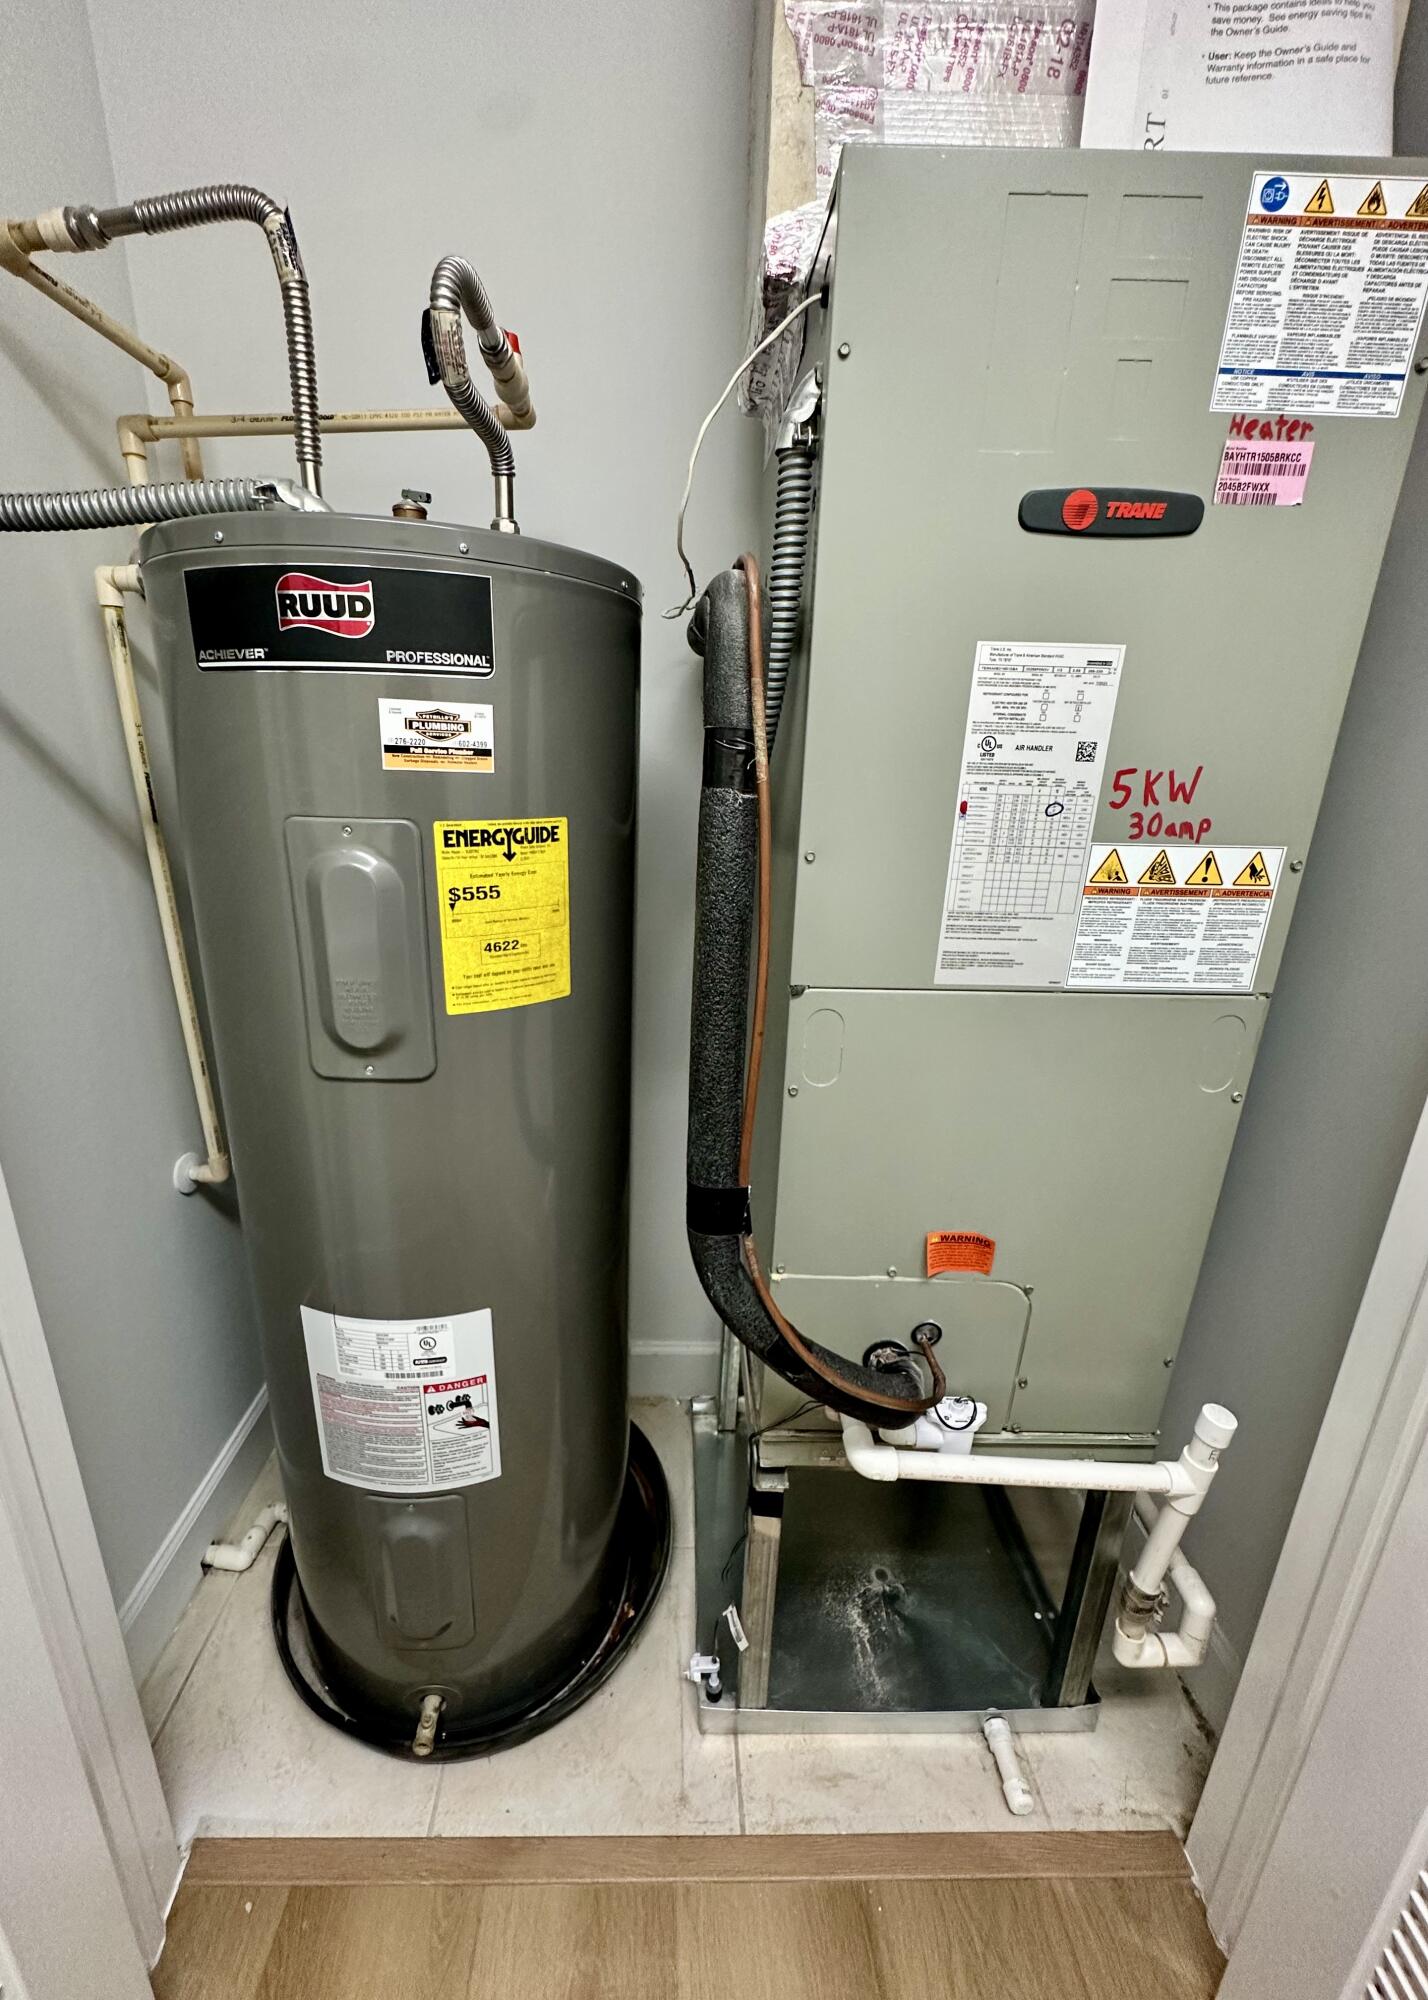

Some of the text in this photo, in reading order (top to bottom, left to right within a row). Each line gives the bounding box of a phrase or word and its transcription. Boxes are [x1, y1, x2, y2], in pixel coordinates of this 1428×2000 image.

[1214, 3, 1231, 12] This
[1232, 3, 1268, 13] package
[1212, 16, 1232, 24] save
[1268, 14, 1286, 22] See
[1288, 10, 1318, 22] energy
[1321, 9, 1348, 20] saving
[1210, 28, 1224, 37] the
[1226, 26, 1260, 37] Owner's
[1208, 42, 1357, 61] User: Keep the Owner's Guide and
[1206, 62, 1244, 73] Warranty
[1246, 58, 1295, 70] information
[1297, 56, 1306, 65] in
[1316, 54, 1334, 64] safe
[1336, 53, 1358, 65] place
[1360, 54, 1372, 64] for
[1206, 76, 1230, 85] future
[1260, 217, 1297, 225] WARNING
[1312, 218, 1376, 228] AVERTISSEMENT
[1228, 412, 1314, 442] Heater
[1106, 501, 1168, 520] TRANE
[280, 594, 372, 620] RUUD
[412, 722, 464, 732] PLUMBING
[443, 826, 560, 849] ENERGYGUIDE
[448, 885, 500, 903] $555
[484, 940, 520, 952] 4622
[940, 1234, 992, 1248] WARNING
[438, 1378, 484, 1392] DANGER
